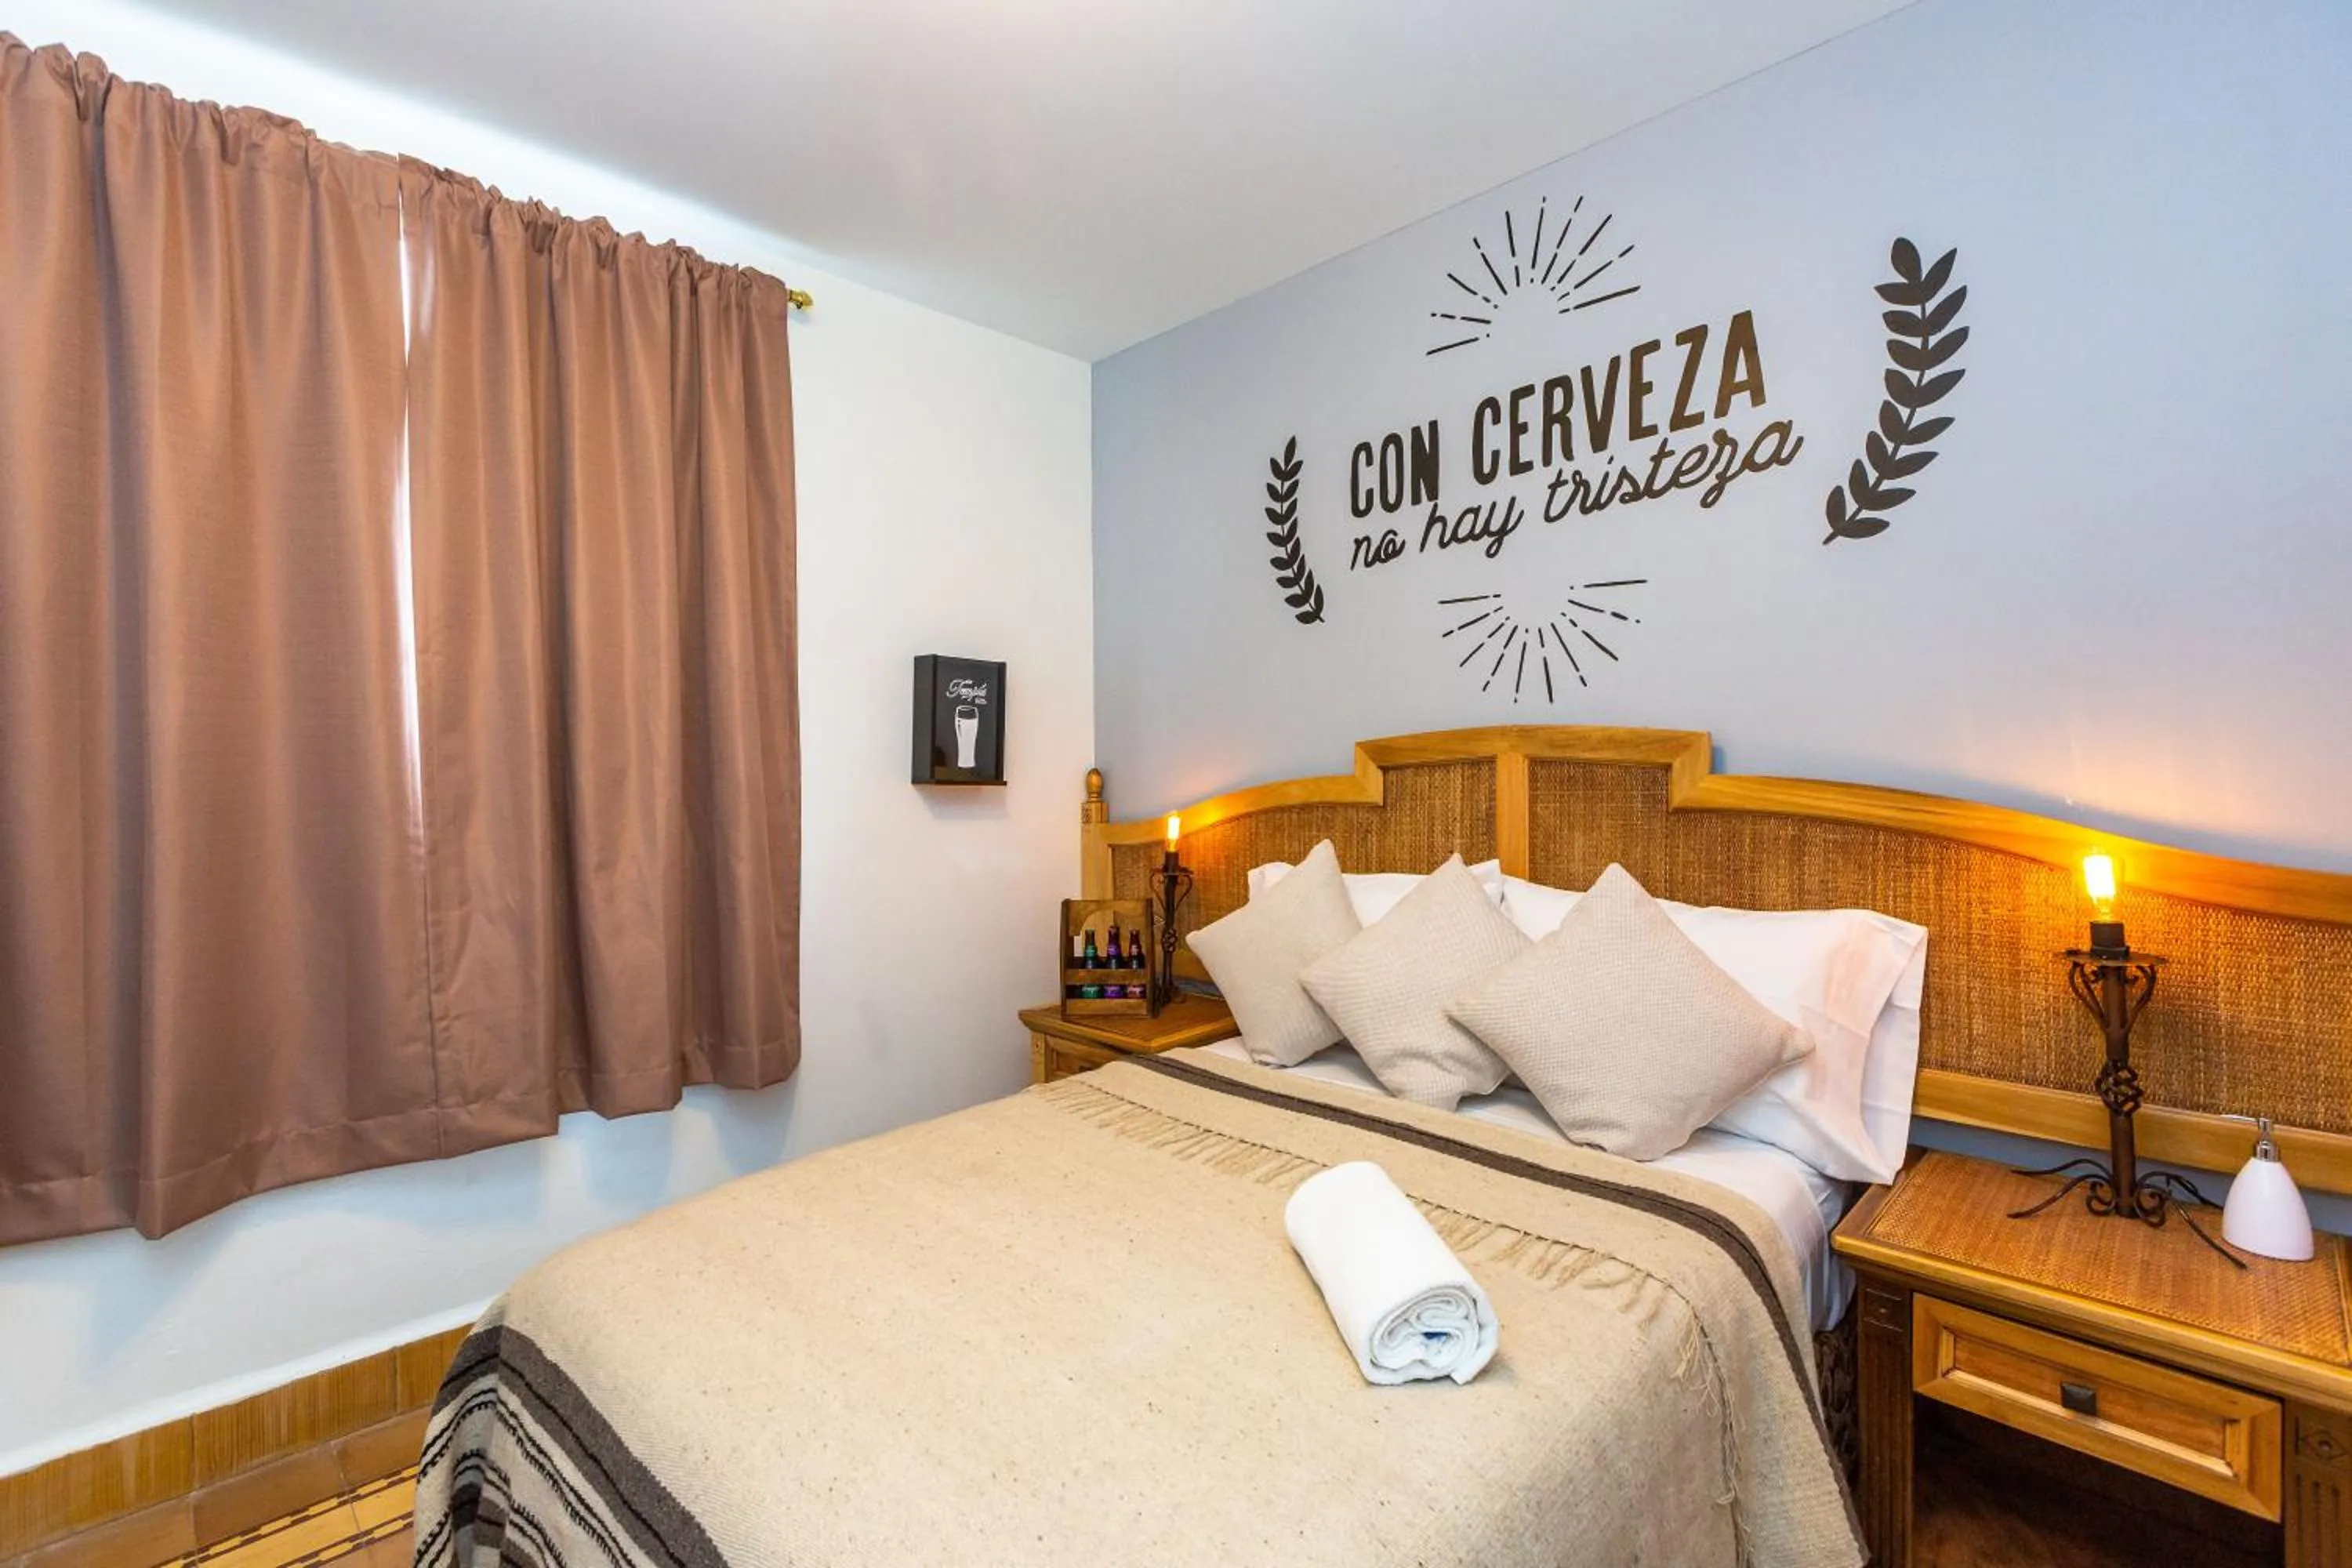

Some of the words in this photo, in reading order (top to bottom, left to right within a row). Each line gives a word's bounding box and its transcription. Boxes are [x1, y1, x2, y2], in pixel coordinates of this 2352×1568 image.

[1350, 419, 1440, 518] CON
[1472, 310, 1766, 486] CERVEZA
[1350, 528, 1406, 572] no
[1419, 495, 1525, 559] hay
[1543, 419, 1805, 524] tristeza
